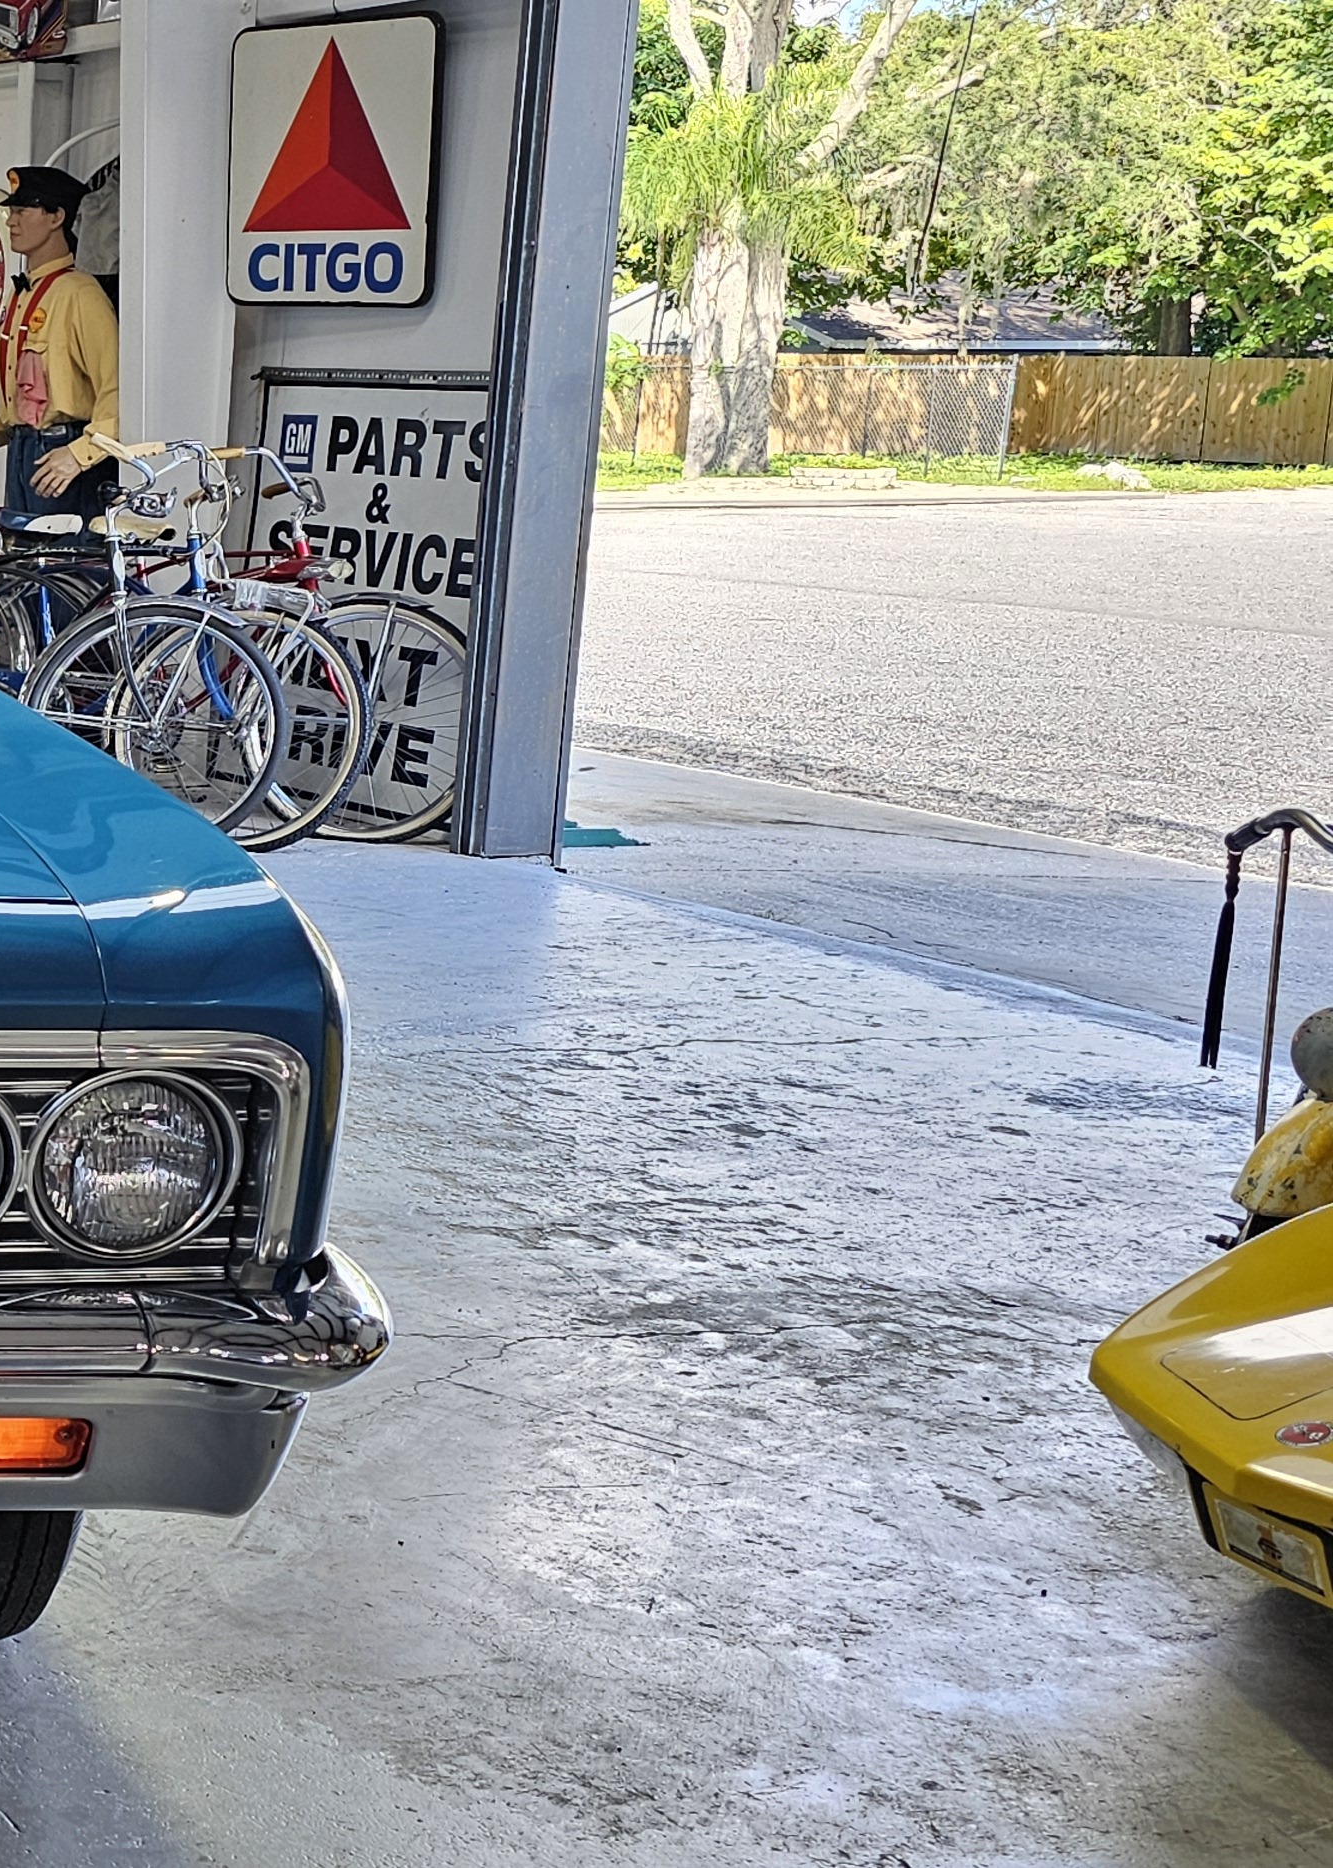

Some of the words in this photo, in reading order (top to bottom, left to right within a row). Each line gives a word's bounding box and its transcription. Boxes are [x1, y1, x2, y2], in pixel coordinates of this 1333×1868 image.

[248, 241, 404, 294] CITGO
[285, 423, 312, 455] GM
[326, 415, 486, 483] PARTS
[365, 483, 391, 525] &
